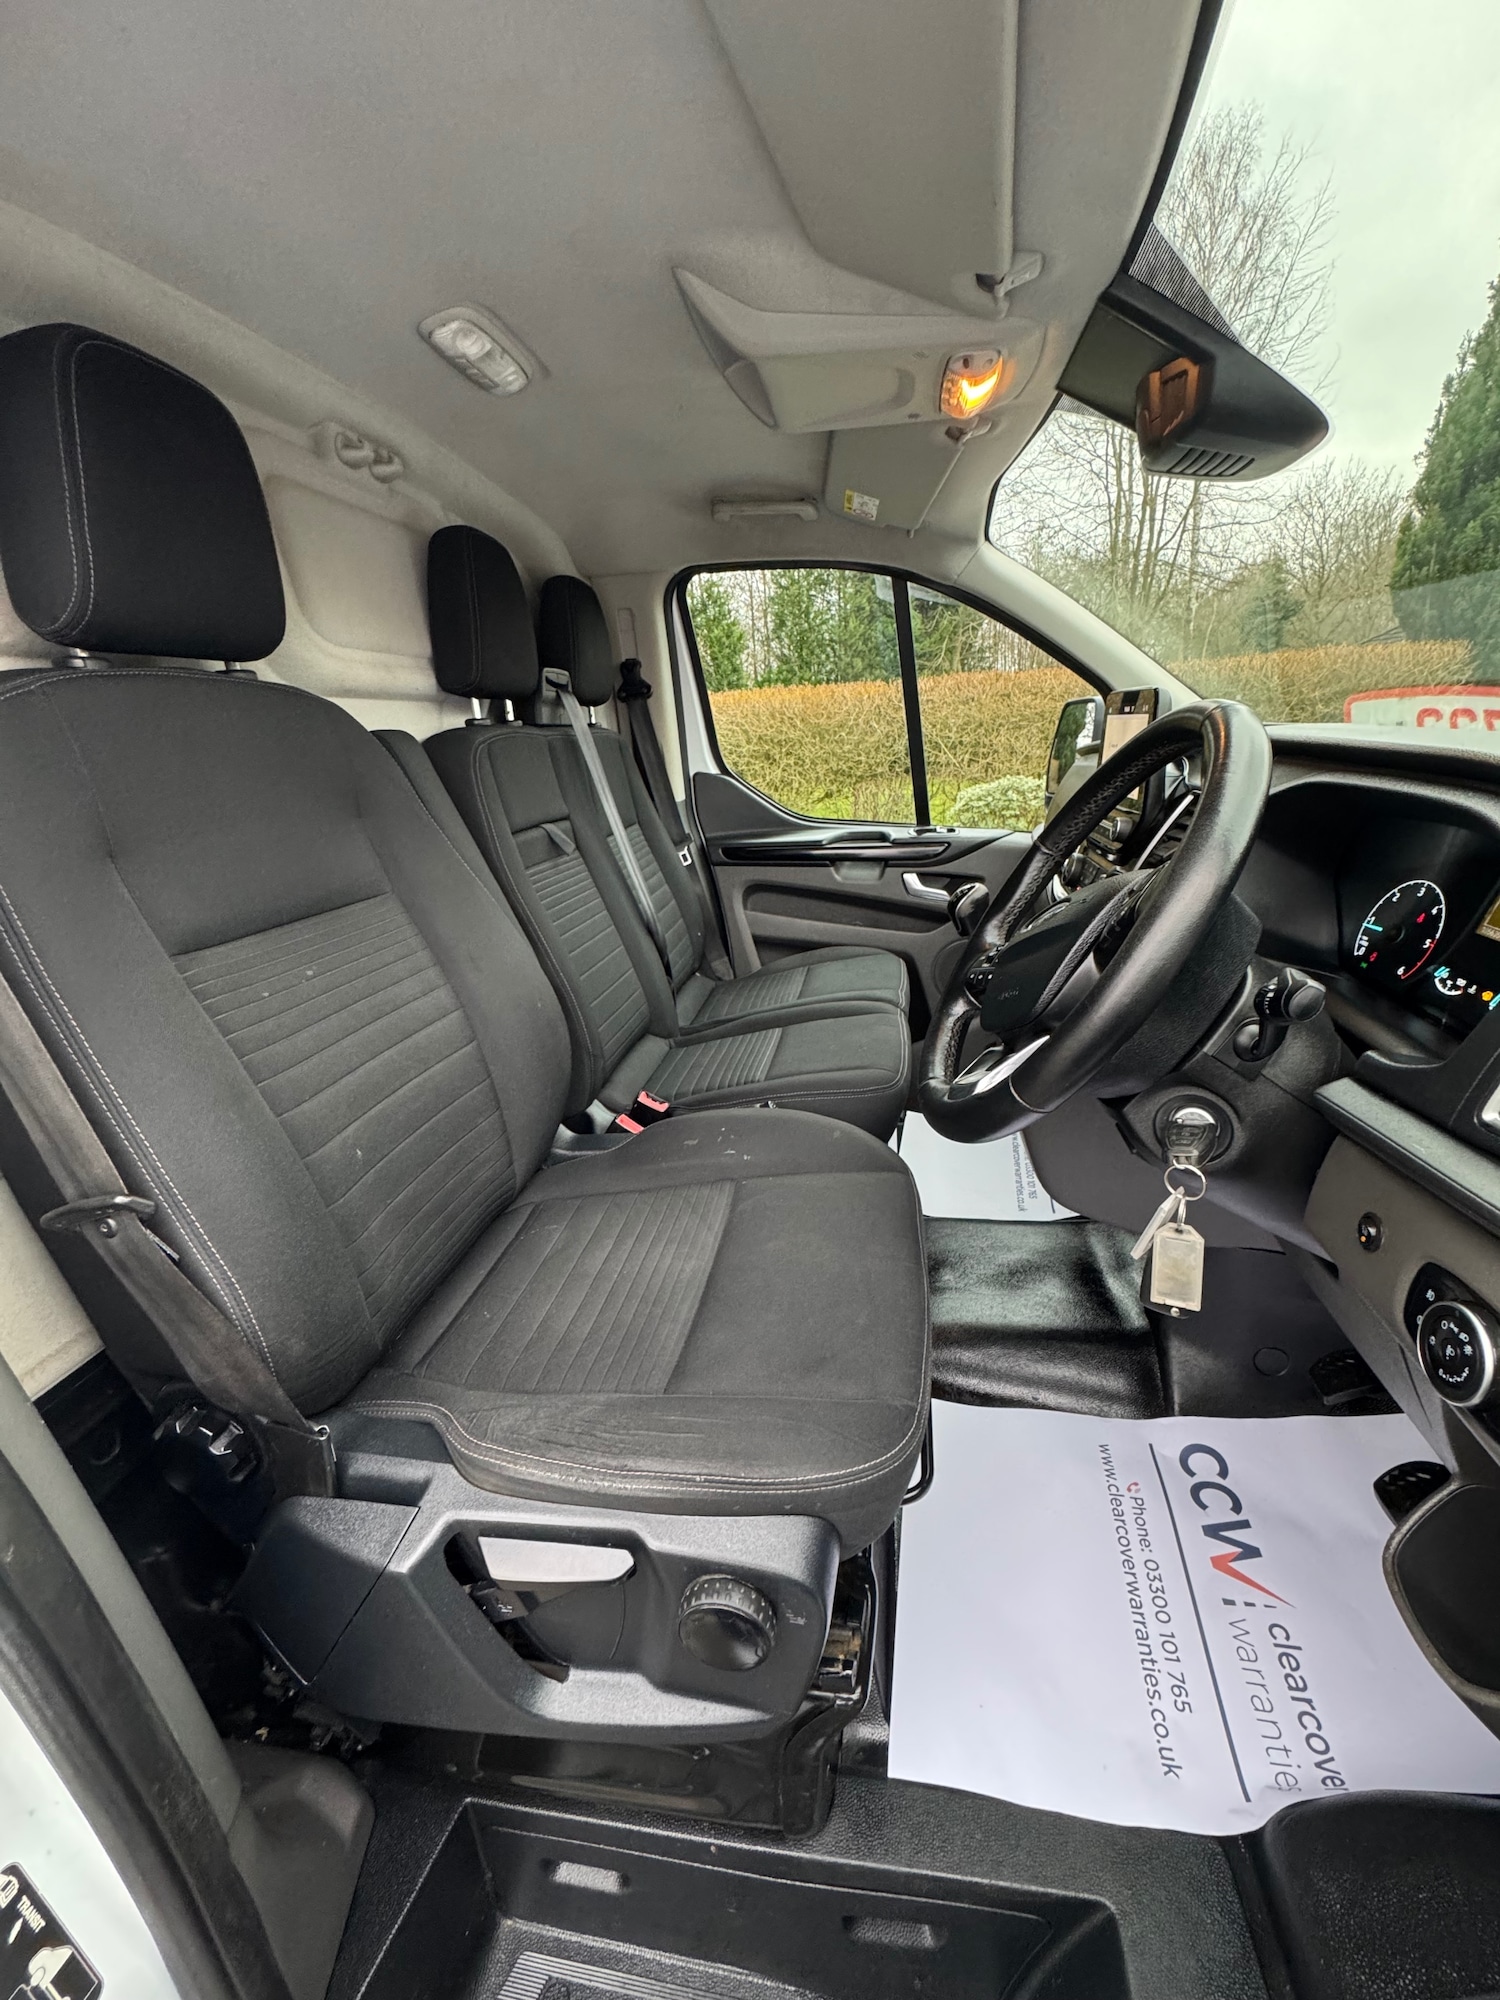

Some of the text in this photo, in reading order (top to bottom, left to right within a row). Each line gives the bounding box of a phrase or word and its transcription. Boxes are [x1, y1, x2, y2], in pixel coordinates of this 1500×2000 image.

[1397, 966, 1406, 976] 6
[1423, 939, 1432, 948] 5
[1179, 1443, 1296, 1608] CCW
[1099, 1443, 1183, 1779] www.clearcoverwarranties.co.uk
[1129, 1495, 1192, 1714] Phone: 03300 101 765
[17, 1895, 46, 1934] TRANSIT
